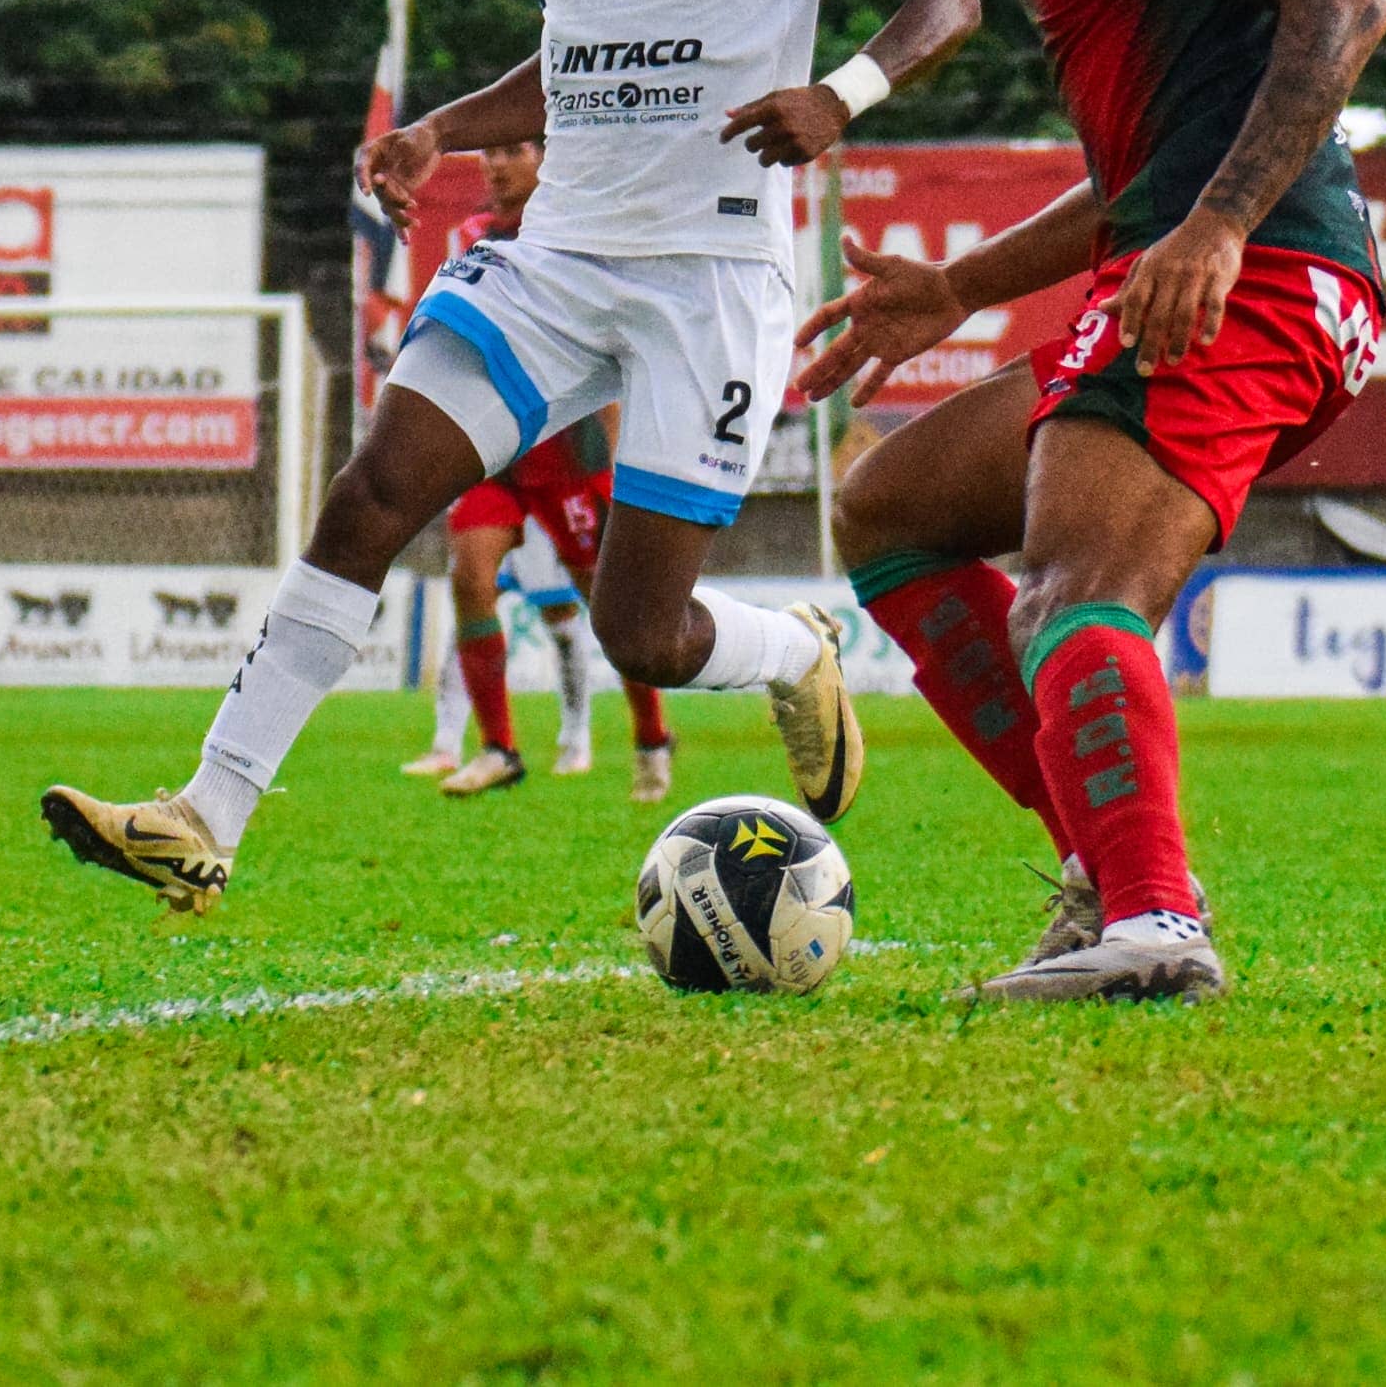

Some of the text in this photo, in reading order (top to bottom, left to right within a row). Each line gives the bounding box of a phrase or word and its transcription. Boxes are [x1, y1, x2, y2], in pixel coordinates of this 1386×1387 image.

[559, 38, 703, 74] INTACO
[623, 112, 637, 125] de
[640, 112, 699, 124] Comercio
[34, 365, 225, 391] CALIDAD
[714, 380, 752, 445] 2
[691, 884, 742, 964] PIONEER
